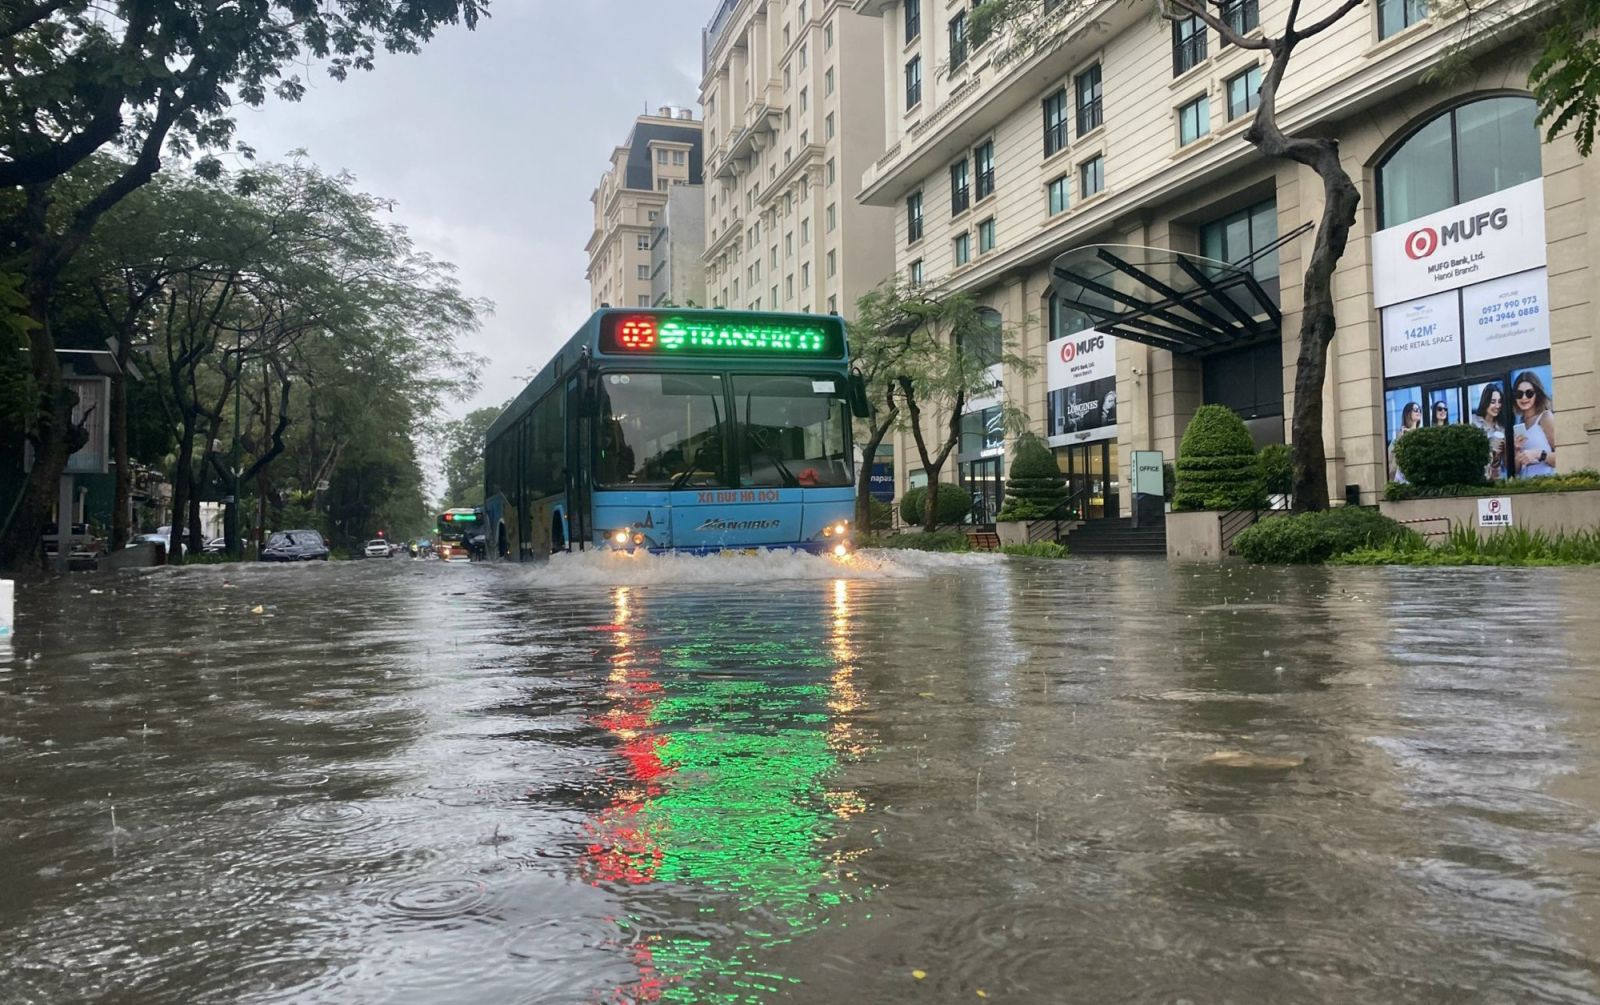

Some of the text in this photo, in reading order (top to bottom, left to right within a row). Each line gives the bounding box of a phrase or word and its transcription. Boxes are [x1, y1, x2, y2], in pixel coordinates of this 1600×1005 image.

[1441, 207, 1508, 246] MUFG
[1428, 251, 1485, 273] MUFG Bank, Ltd.
[1455, 264, 1479, 276] Branch
[1076, 335, 1104, 355] MUFG
[1390, 334, 1453, 352] PRIME RETAIL SPACE
[1067, 400, 1098, 415] LONGINES
[871, 475, 892, 484] napas
